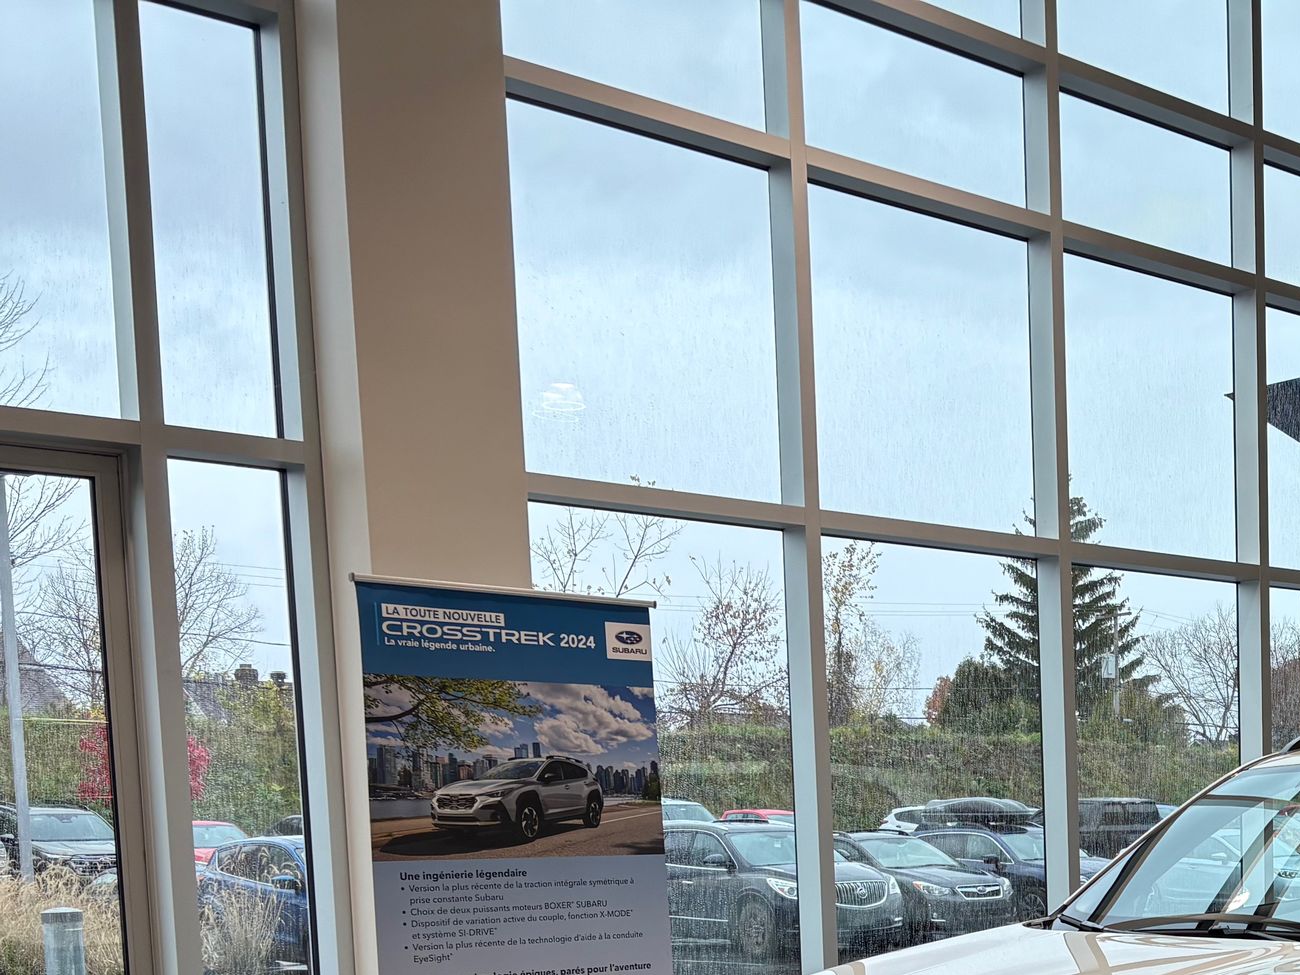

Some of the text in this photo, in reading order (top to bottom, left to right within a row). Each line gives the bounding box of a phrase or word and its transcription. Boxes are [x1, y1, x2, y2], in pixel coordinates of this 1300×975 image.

[386, 606, 501, 624] LA TOUTE NOUVELLE
[382, 620, 596, 648] CROSSTREK 2024
[384, 636, 496, 652] La vraie légende urbaine.
[400, 868, 527, 882] Une ingénierie légendaire
[452, 883, 468, 893] plus
[555, 878, 587, 888] intégrale
[590, 878, 628, 888] symétrique
[410, 896, 430, 905] prise
[475, 893, 504, 902] Subaru
[473, 904, 510, 914] puissants
[576, 900, 608, 908] SUBARU
[411, 918, 450, 928] Dispositif
[466, 916, 500, 924] variation
[539, 913, 566, 922] couple,
[568, 912, 598, 920] fonction
[422, 931, 456, 940] système
[456, 940, 472, 950] plus
[528, 936, 572, 944] technologie
[574, 934, 596, 942] d'aide
[612, 931, 643, 939] conduite
[587, 966, 608, 975] pour
[610, 963, 651, 972] l'aventure
